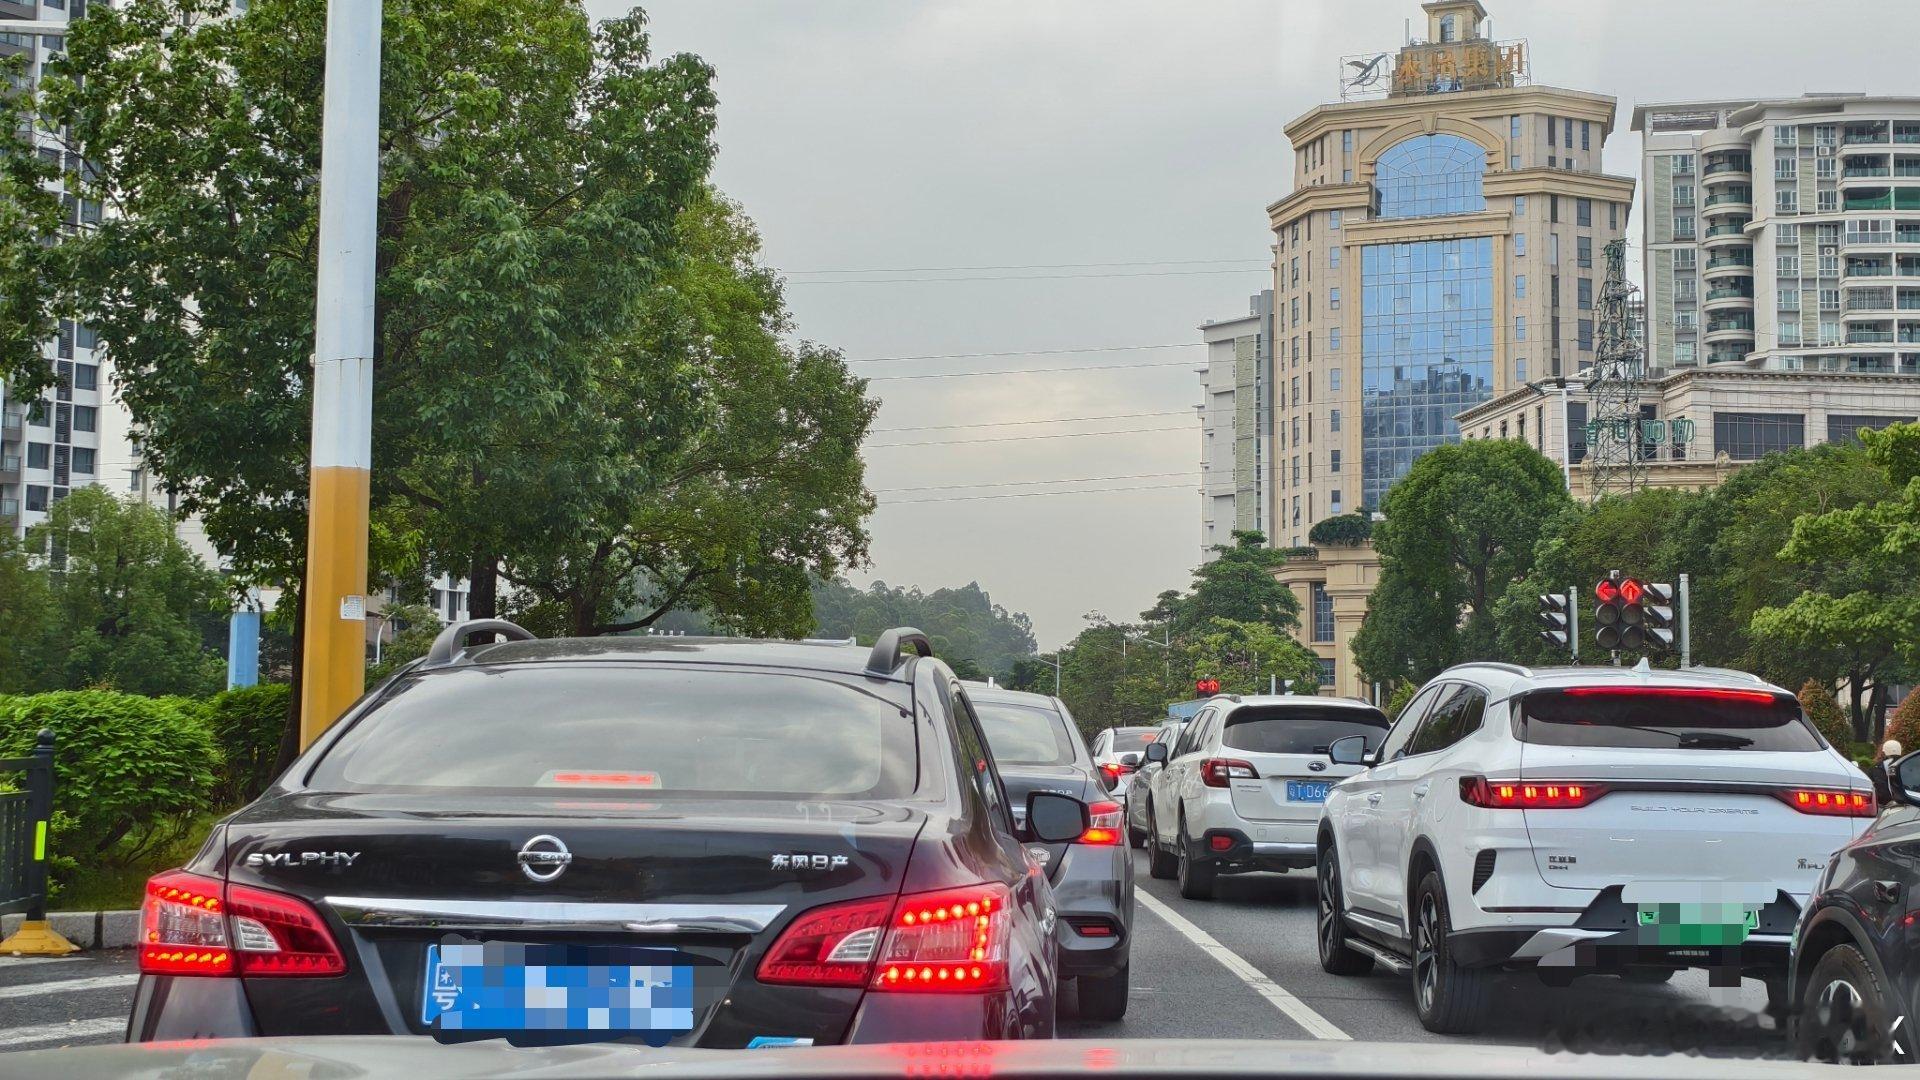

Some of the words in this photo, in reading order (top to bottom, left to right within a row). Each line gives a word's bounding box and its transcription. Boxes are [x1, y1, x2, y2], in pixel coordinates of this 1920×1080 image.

[247, 851, 361, 866] SYLPHY
[520, 853, 570, 863] NISSAN
[771, 854, 848, 871] 东风日产
